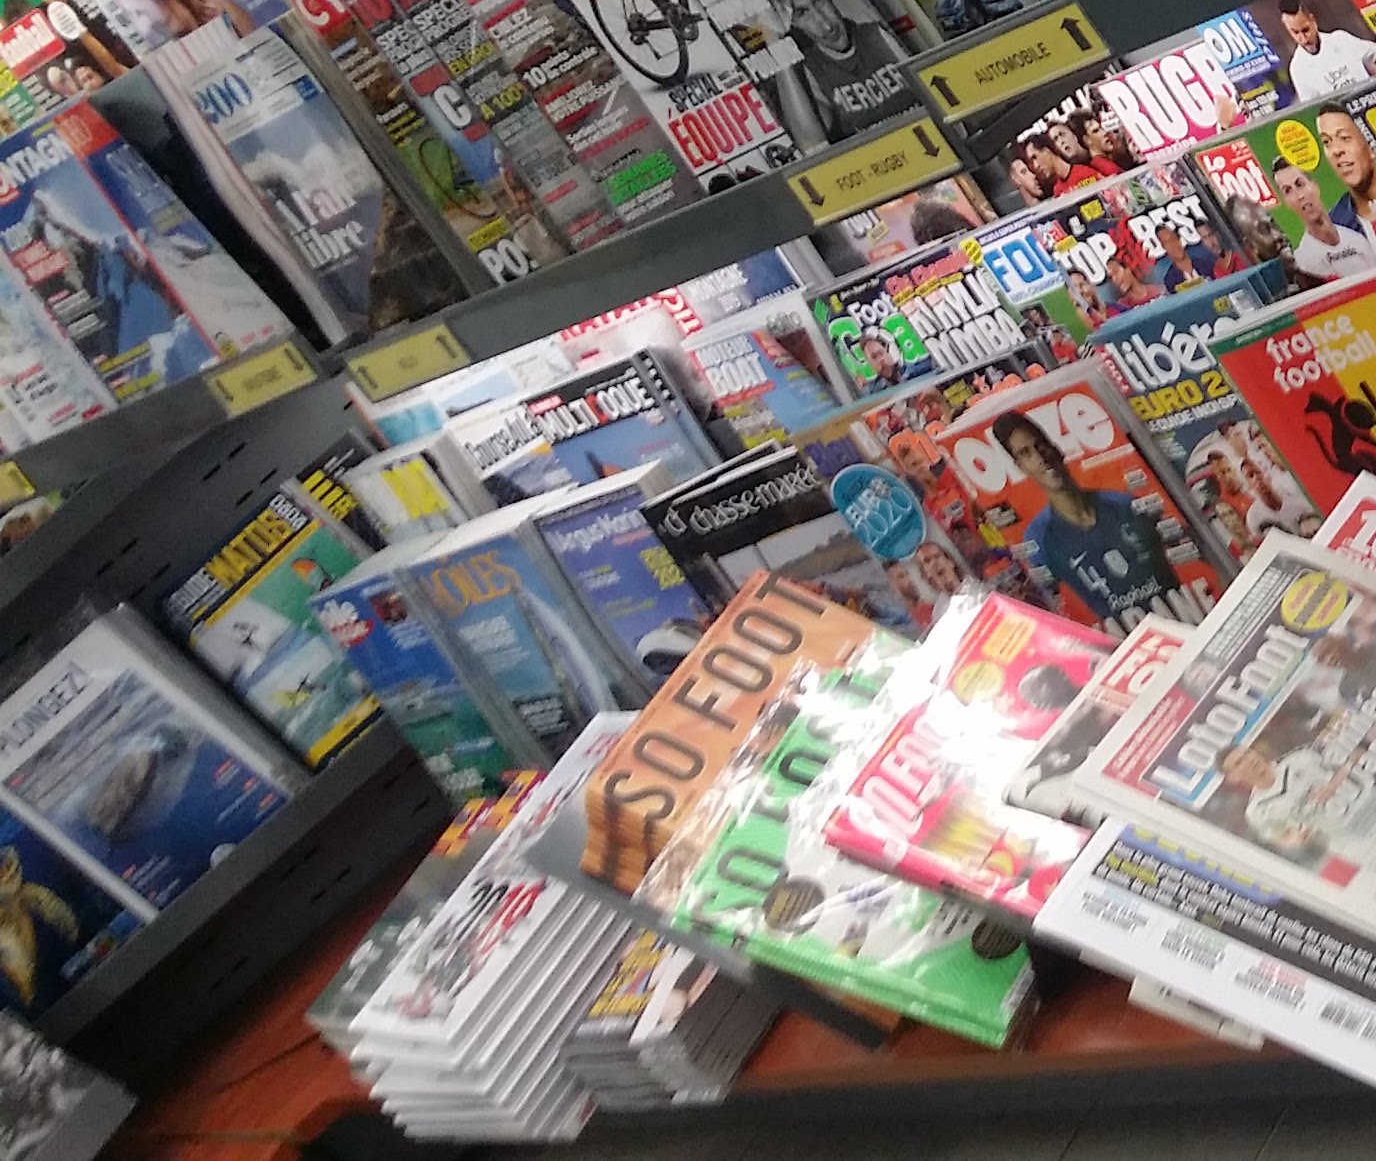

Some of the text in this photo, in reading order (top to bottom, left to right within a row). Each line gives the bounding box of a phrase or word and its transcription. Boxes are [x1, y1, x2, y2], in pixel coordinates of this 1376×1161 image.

[976, 40, 1052, 85] AUTOMOBILE
[667, 82, 777, 170] ÉQUIPE
[1268, 314, 1354, 363] france
[606, 576, 830, 824] SO FOOT
